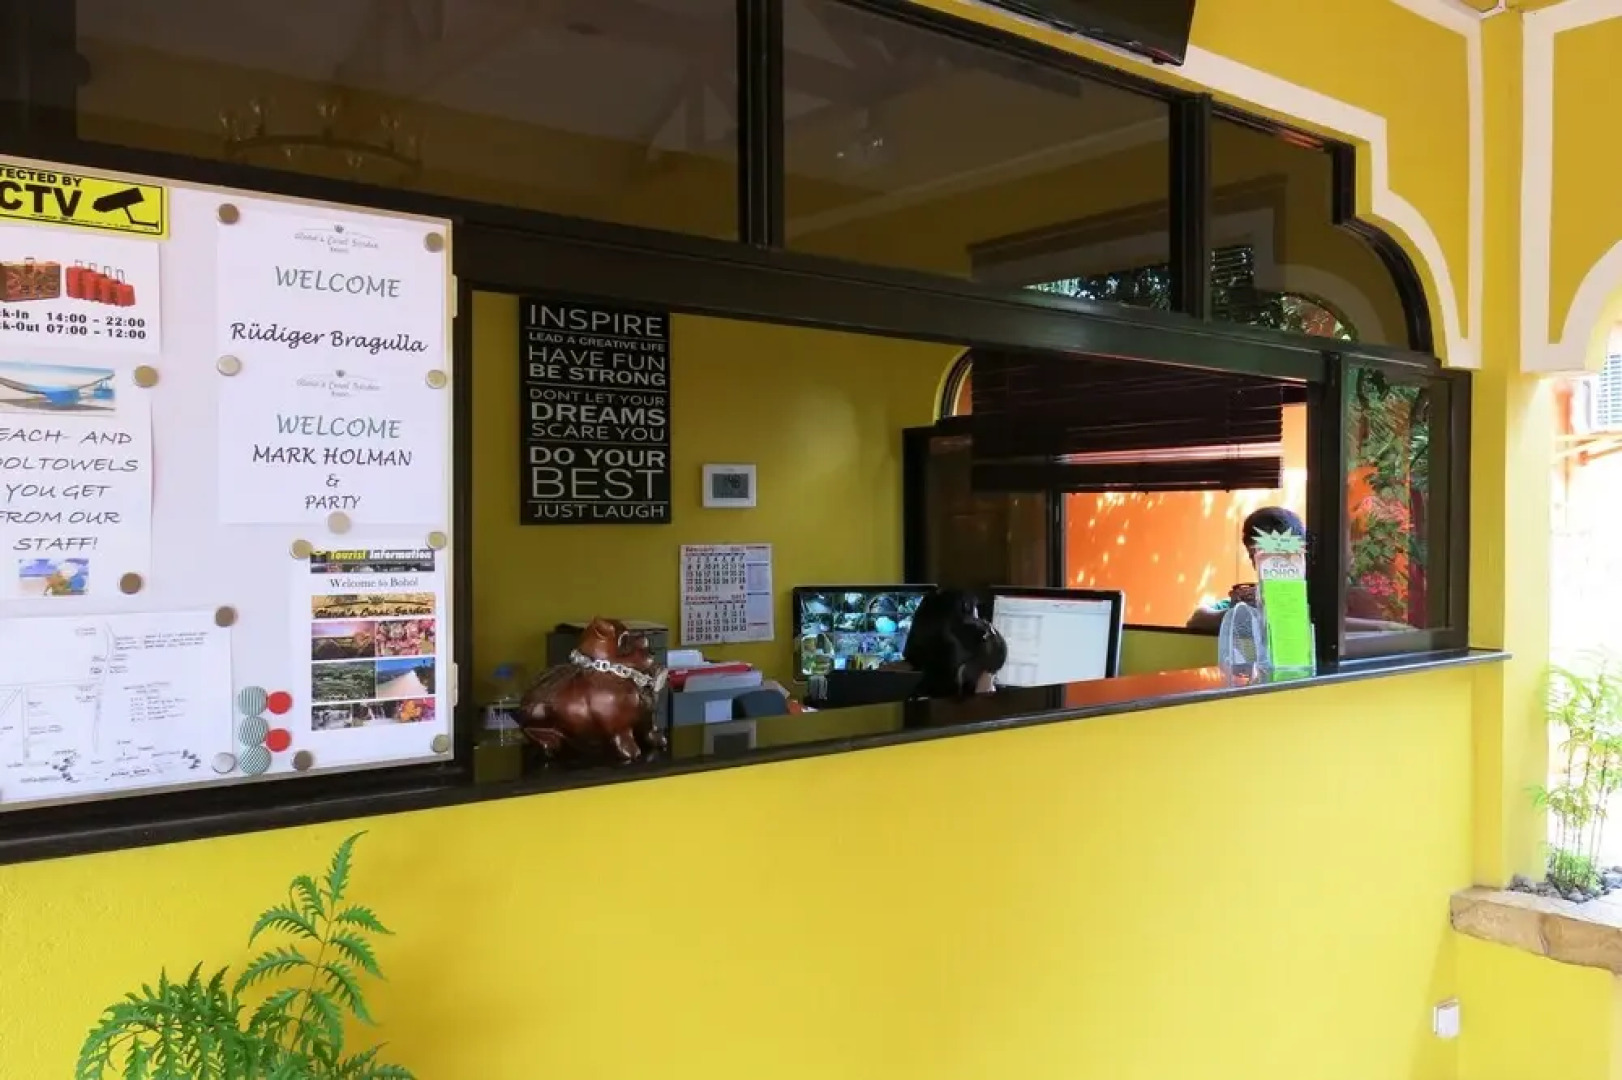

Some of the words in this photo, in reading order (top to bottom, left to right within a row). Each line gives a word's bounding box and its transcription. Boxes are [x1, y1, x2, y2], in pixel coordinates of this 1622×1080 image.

[62, 176, 82, 187] BY
[275, 266, 401, 298] WELCOME
[0, 307, 30, 320] k-In
[46, 312, 87, 324] 14:00
[106, 316, 146, 328] 22:00
[529, 304, 663, 338] INSPIRE
[0, 321, 40, 333] k-Out
[46, 324, 88, 336] 07:00
[107, 328, 147, 340] 12:00
[229, 322, 325, 349] Rüdiger
[330, 331, 428, 355] Bragulla
[528, 331, 563, 343] LEAD
[567, 336, 576, 345] A
[578, 336, 637, 350] CREATIVE
[640, 341, 666, 352] LIFE
[528, 345, 604, 368] HAVE
[612, 352, 666, 372] FUN
[529, 363, 561, 380] BE
[568, 367, 666, 386] STRONG
[529, 388, 582, 402] DONT
[585, 393, 616, 404] LET
[619, 395, 665, 407] YOUR
[531, 402, 666, 427] DREAMS
[277, 414, 402, 439] WELCOME
[531, 422, 610, 440] SCARE
[616, 427, 665, 442] YOU
[80, 430, 133, 445] AND
[0, 456, 139, 473] OLTOWELS
[252, 444, 317, 466] MARK
[323, 447, 413, 467] HOLMAN
[529, 446, 576, 465] DO
[583, 448, 666, 468] YOUR
[325, 473, 340, 488] &
[531, 466, 664, 500] BEST
[6, 483, 56, 503] YOU
[62, 484, 112, 499] GET
[304, 494, 361, 511] PARTY
[67, 510, 121, 524] OUR
[533, 503, 588, 518] JUST
[592, 504, 664, 519] LAUGH
[12, 536, 98, 551] STAFF!
[369, 549, 432, 560] Information
[328, 577, 376, 589] Welcome
[378, 578, 388, 588] to
[390, 576, 419, 588] Bohol
